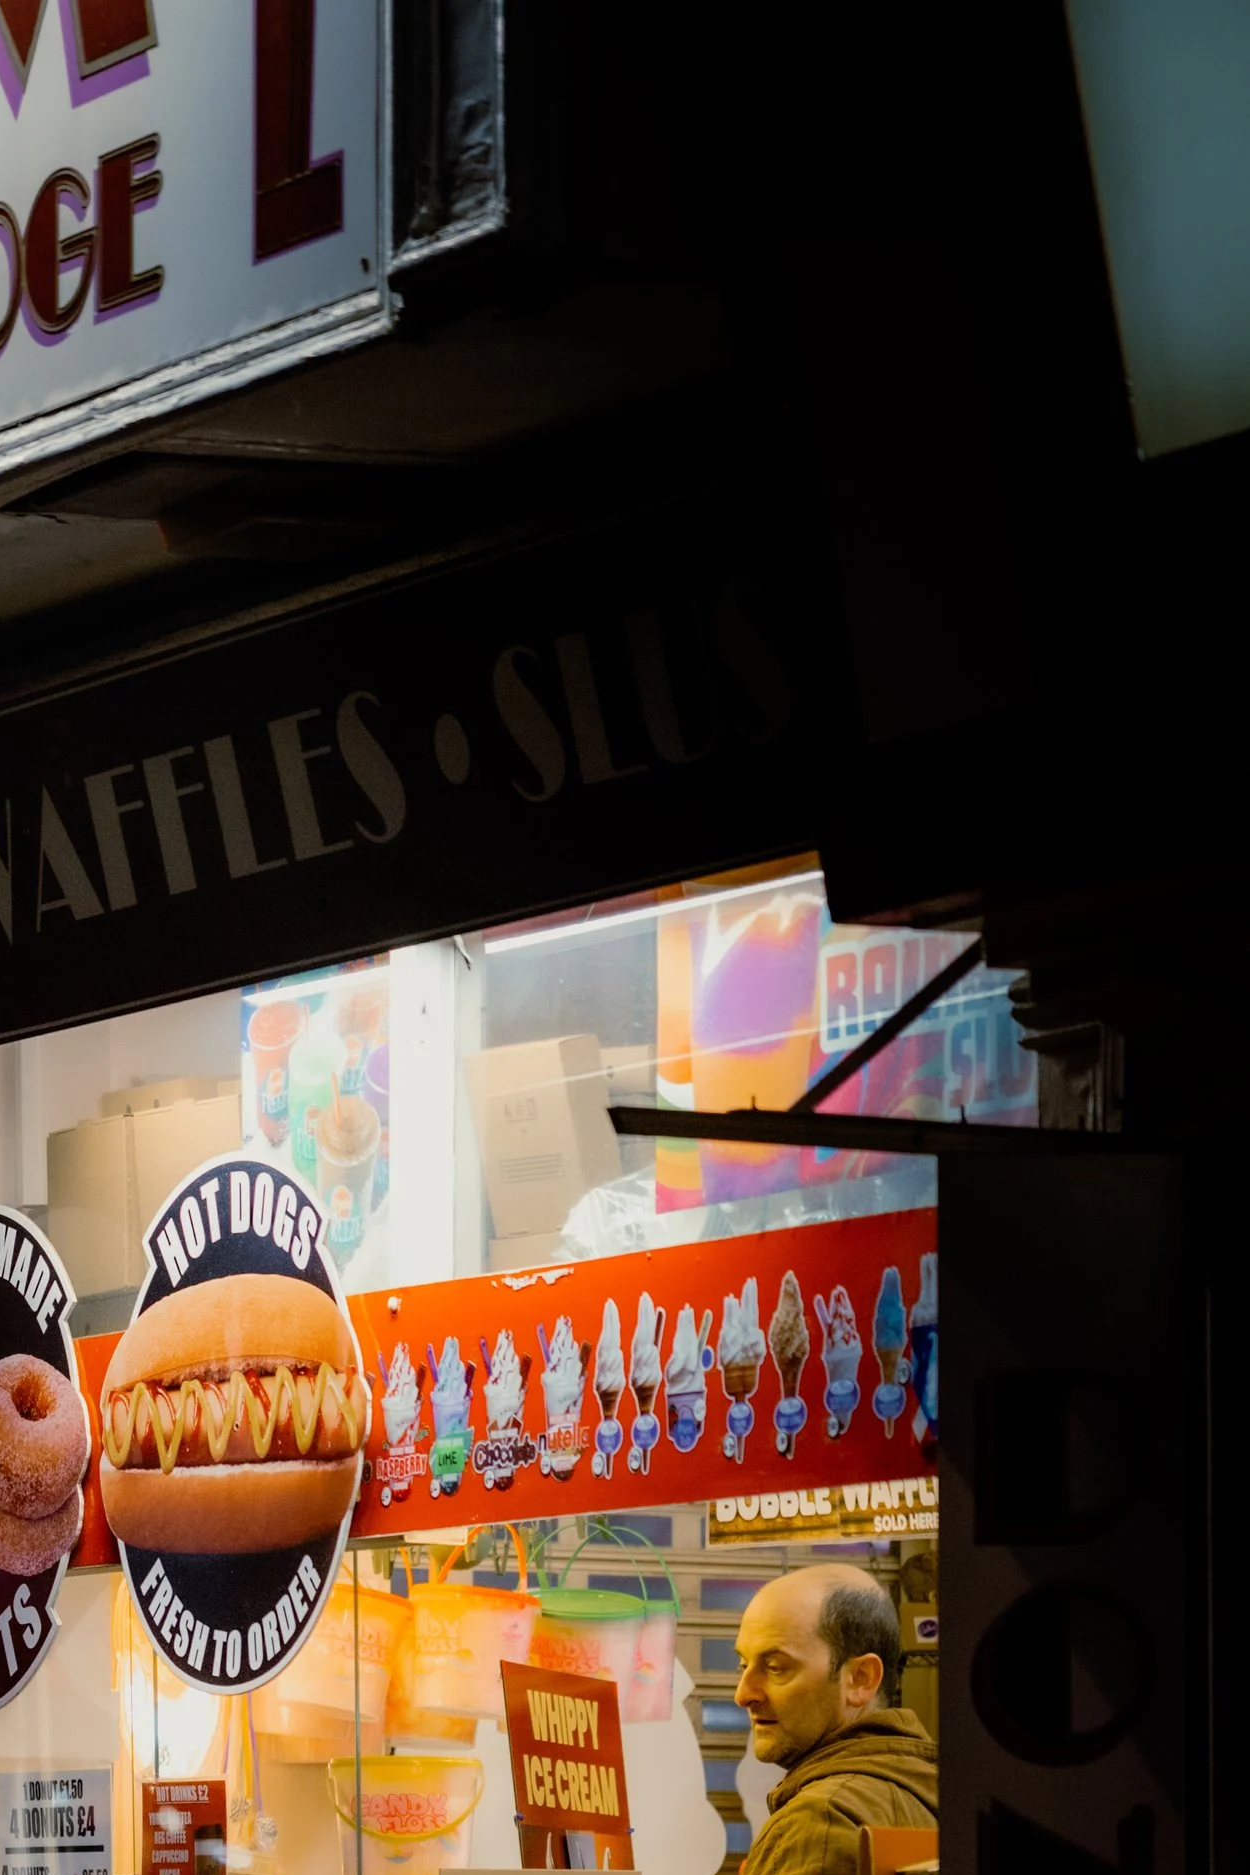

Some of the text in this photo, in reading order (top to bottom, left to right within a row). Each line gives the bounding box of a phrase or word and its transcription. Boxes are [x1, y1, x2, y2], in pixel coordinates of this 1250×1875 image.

[157, 1170, 318, 1287] HOT DOGS
[538, 1424, 590, 1452] nutella
[377, 1453, 428, 1480] RASPBERRY
[437, 1451, 458, 1466] LIME
[873, 1515, 908, 1533] SOLD
[140, 1553, 322, 1679] FRESH TO ORDER
[526, 1688, 599, 1751] WHIPPY
[29, 1781, 58, 1801] DONUT
[156, 1784, 209, 1802] HOT DRINKS £2
[523, 1754, 620, 1817] ICE CREAM
[10, 1805, 96, 1839] 4 DONUTS £4
[377, 1815, 448, 1834] FLOSS
[166, 1831, 187, 1844] COFFEE
[152, 1850, 189, 1863] CAPPUCCINO
